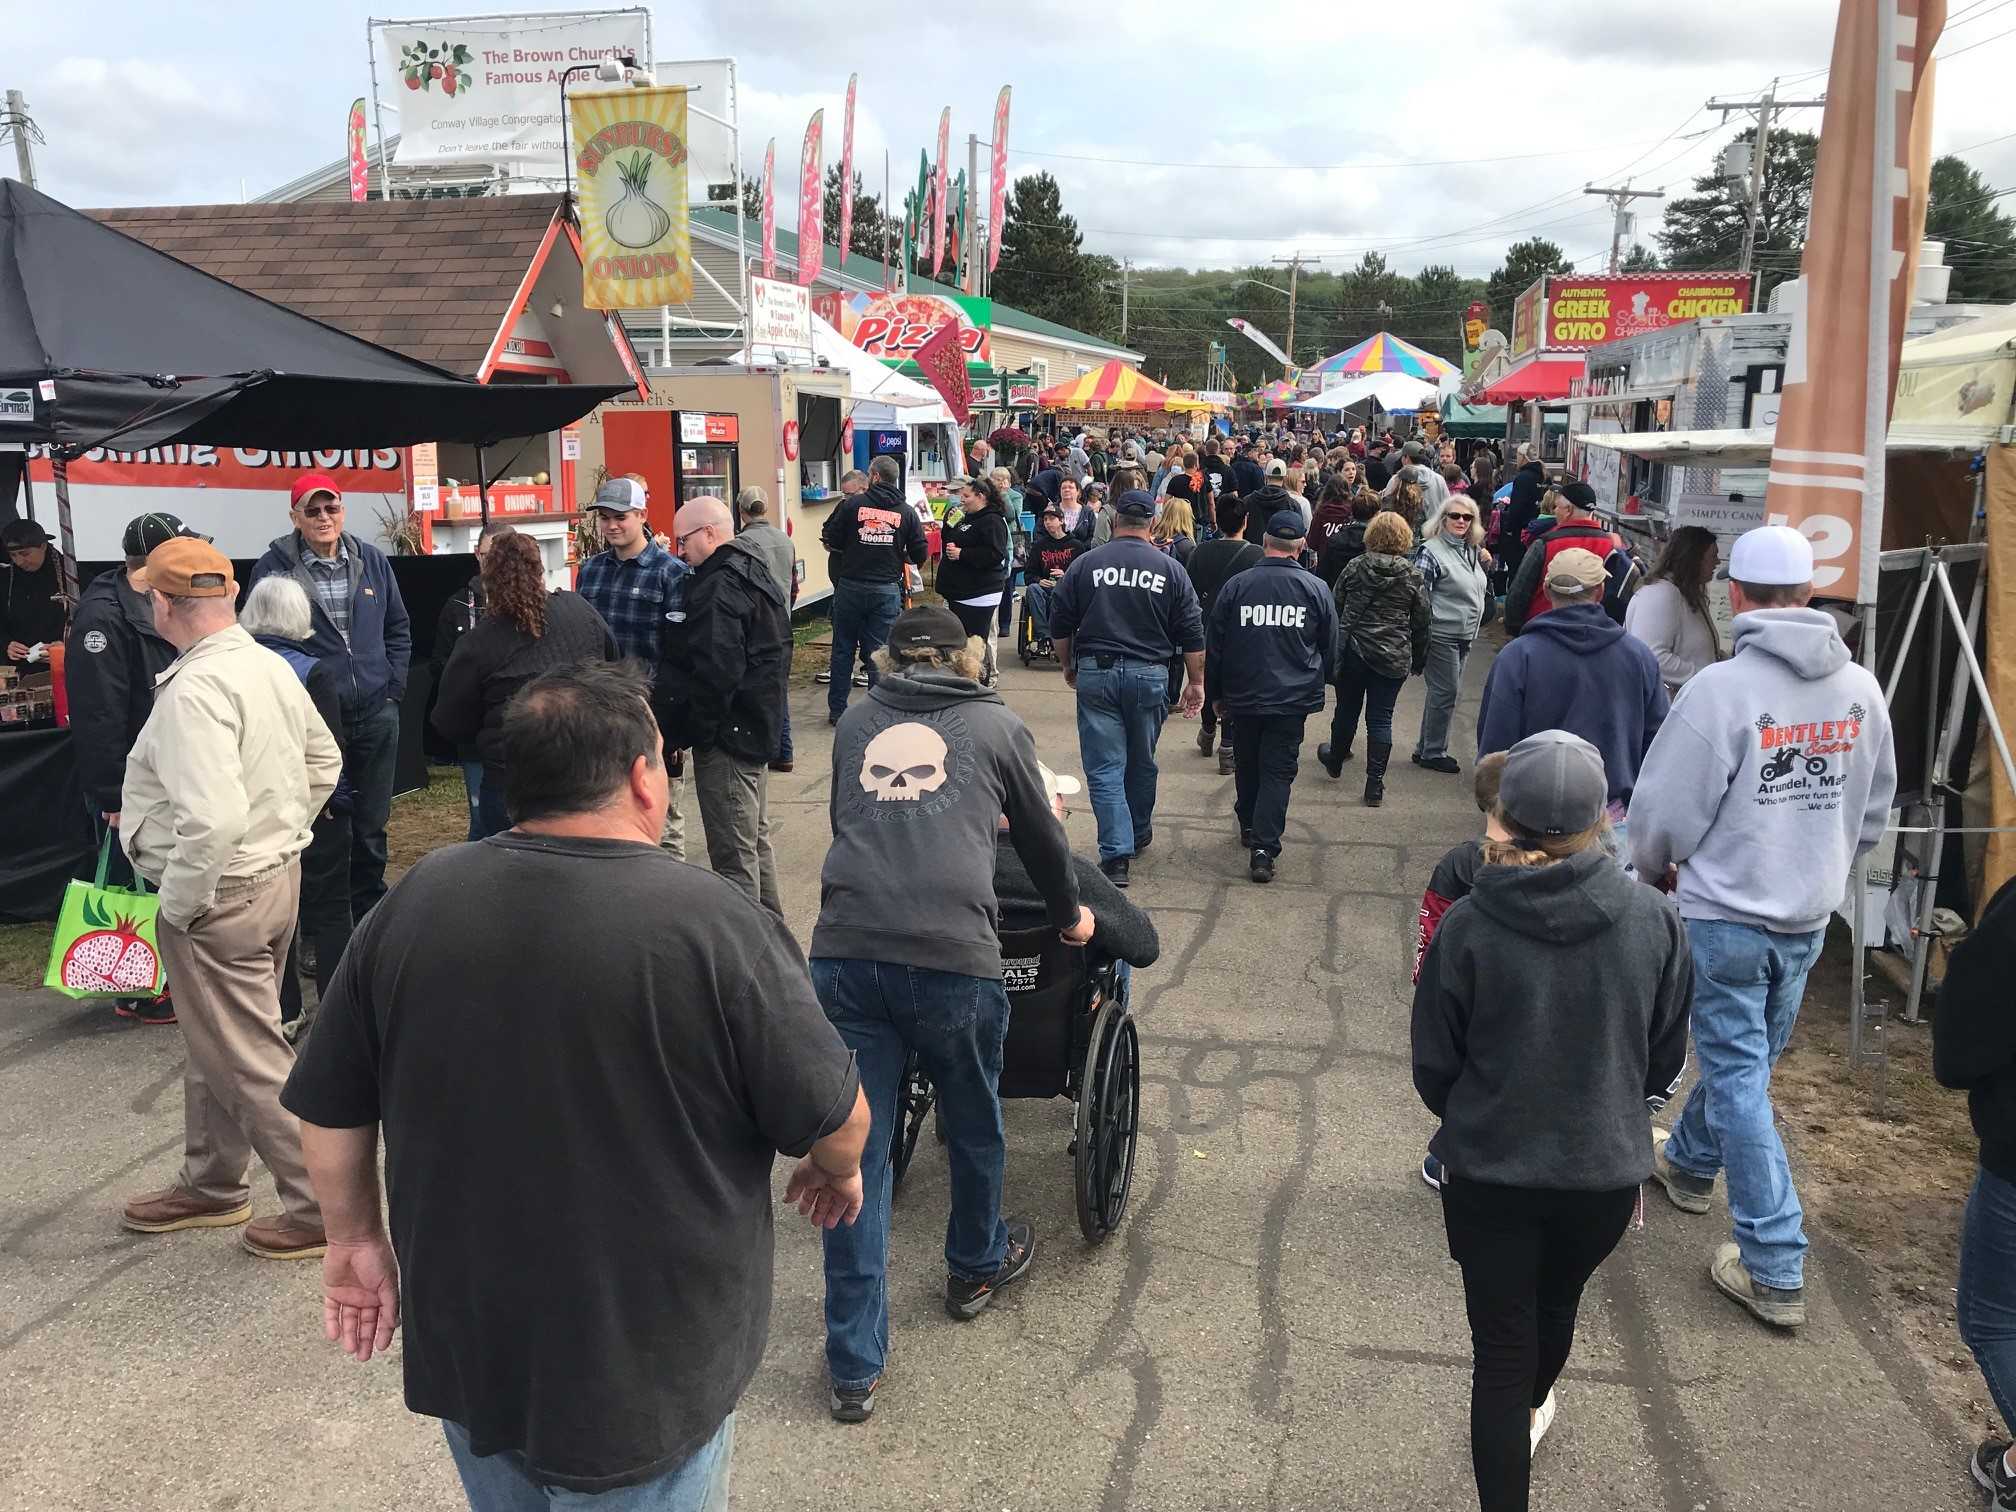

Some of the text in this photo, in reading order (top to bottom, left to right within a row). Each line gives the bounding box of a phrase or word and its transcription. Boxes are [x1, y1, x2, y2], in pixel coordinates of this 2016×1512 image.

[482, 44, 636, 65] The Brown Church's
[485, 71, 543, 86] Famous
[547, 68, 594, 86] Apple
[431, 117, 466, 130] Conway
[468, 115, 500, 130] Village
[438, 144, 463, 153] Don't
[491, 140, 509, 151] the
[511, 140, 529, 151] fair
[531, 138, 568, 150] withou
[592, 251, 680, 281] ONIONS
[1560, 287, 1607, 298] AUTHENTIC
[1553, 299, 1744, 319] GREEK CHICKEN
[850, 314, 984, 354] Piza
[1554, 322, 1607, 341] GYRO
[886, 436, 902, 447] pepsi
[504, 493, 536, 512] ONIONS
[1092, 567, 1167, 594] POLICE
[1239, 604, 1307, 628] POLICE
[1760, 716, 1862, 749] BENTLEY'S
[1758, 777, 1812, 794] Arundel,
[1788, 792, 1811, 801] more
[1813, 791, 1829, 800] fun
